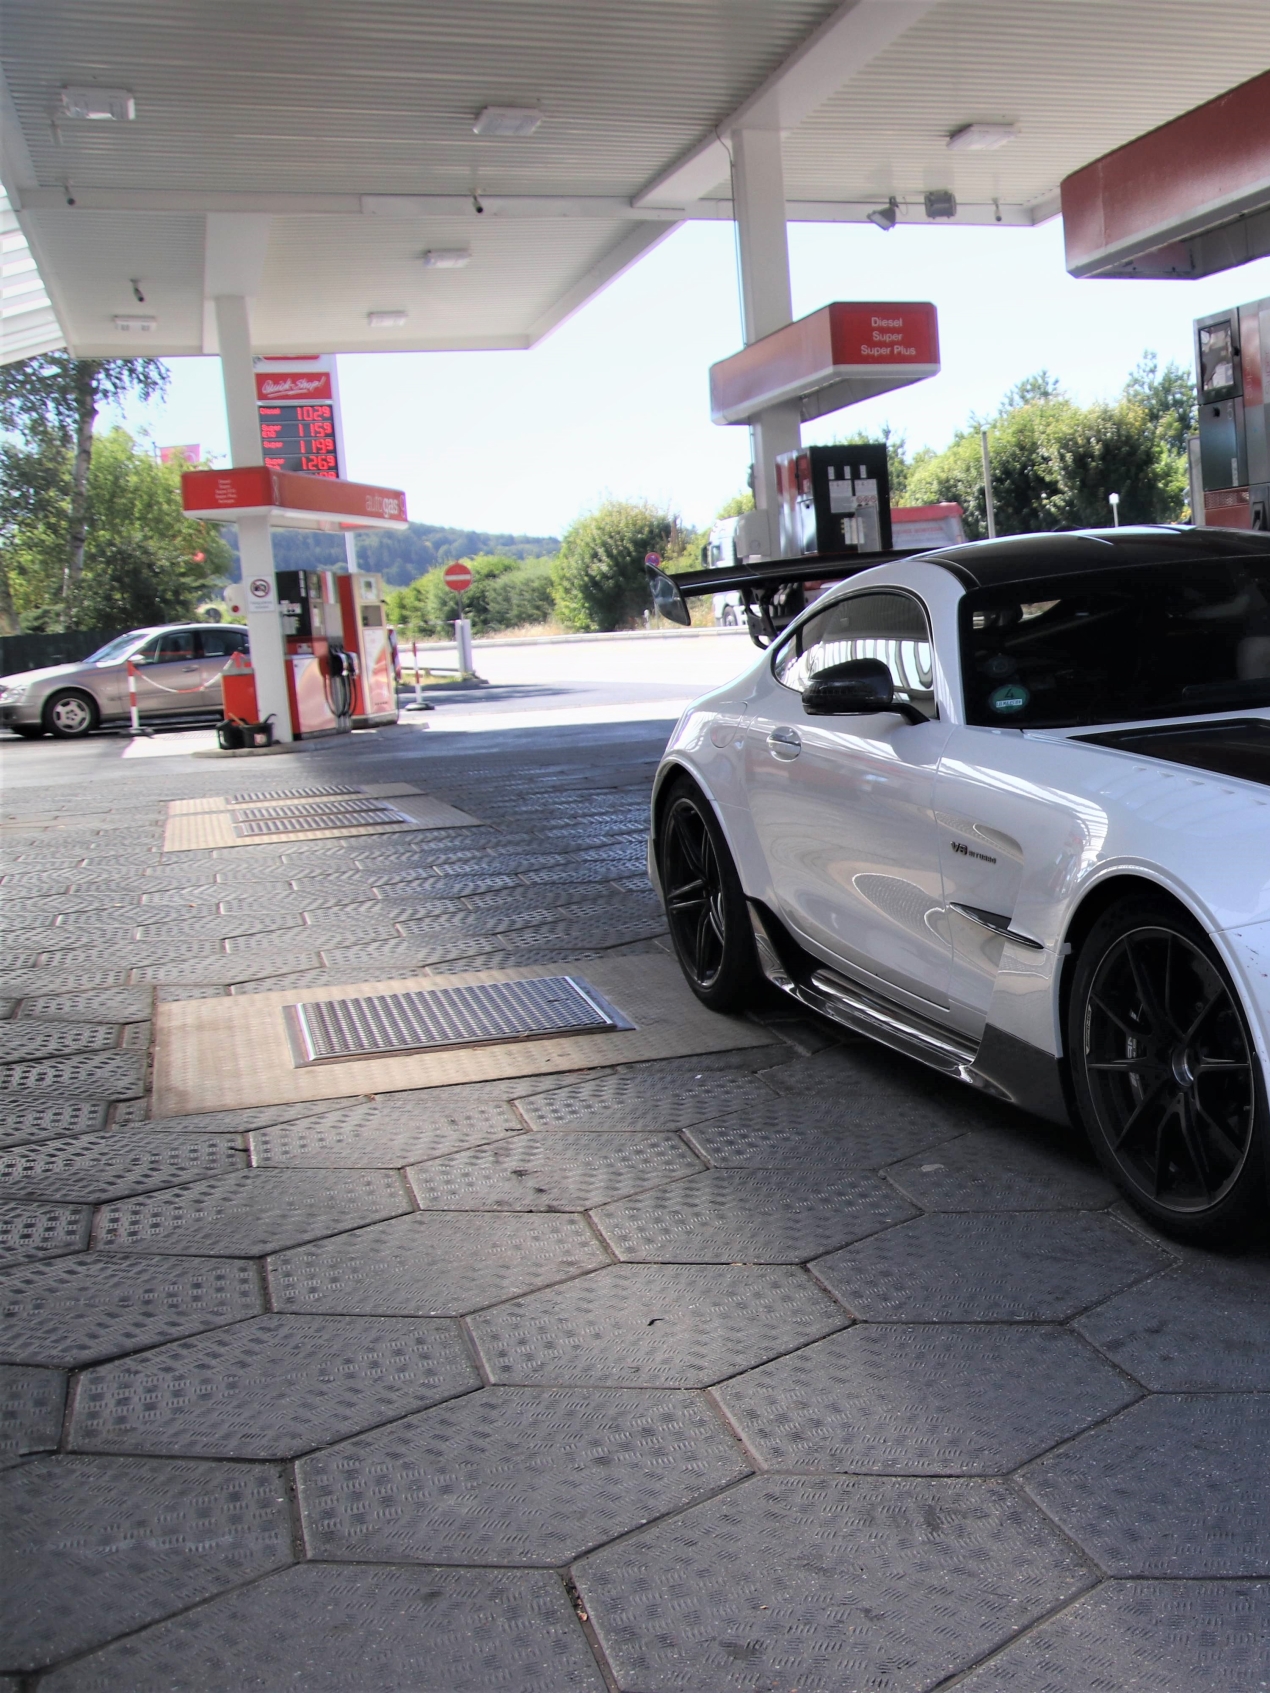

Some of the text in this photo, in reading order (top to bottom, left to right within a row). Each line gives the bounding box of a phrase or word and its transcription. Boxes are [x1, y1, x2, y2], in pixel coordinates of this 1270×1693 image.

[871, 316, 903, 327] Diesel
[872, 330, 903, 343] Super
[860, 345, 916, 357] Super Plus
[296, 405, 331, 421] 1029
[366, 493, 399, 518] autogas
